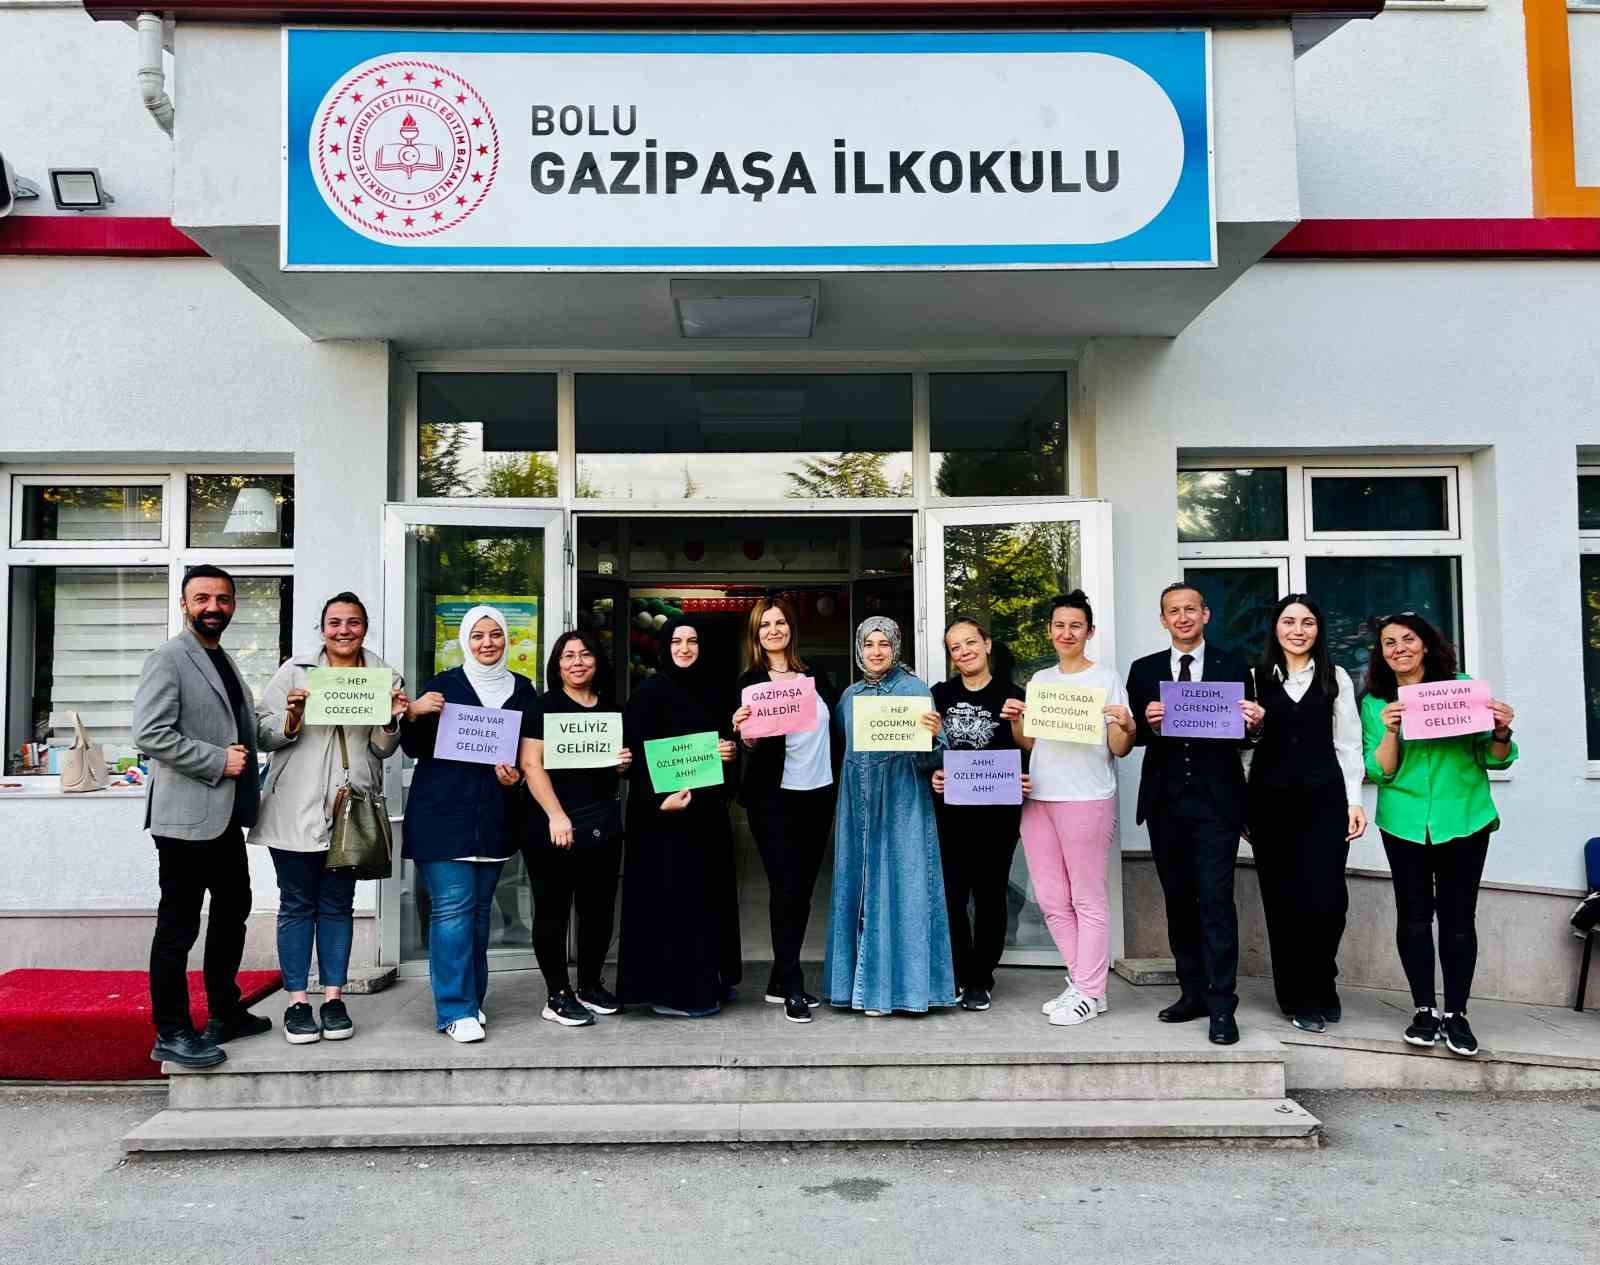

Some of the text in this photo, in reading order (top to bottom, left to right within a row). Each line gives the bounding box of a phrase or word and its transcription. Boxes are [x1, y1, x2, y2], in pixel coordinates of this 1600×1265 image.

[405, 94, 438, 109] MİLLİ
[438, 107, 466, 145] EĞİTİM
[531, 104, 637, 136] BOLU
[353, 94, 401, 161] CUMHURİYETİ
[423, 148, 466, 203] BAKANLIĞI
[530, 138, 1120, 202] GAZİPAŞA İLKOKULU
[347, 677, 367, 686] HEP
[752, 688, 802, 701] GAZİPAŞA
[1058, 693, 1094, 703] OLSADA
[1181, 688, 1224, 699] İZLEDİM,
[1418, 687, 1471, 698] SINAV VAR
[757, 704, 800, 717] AİLEDİR!
[890, 706, 909, 714] HEP
[457, 712, 504, 725] SINAV VAR
[1424, 714, 1472, 728] GELDİK!
[560, 720, 608, 733] VELİYİZ
[456, 741, 498, 754] GELDİK!
[557, 740, 611, 754] GELİRİZ!
[672, 743, 693, 752] AHH!
[686, 753, 714, 764] HANIM
[675, 768, 696, 778] AHH!
[985, 771, 1014, 780] HANIM
[972, 785, 994, 793] AHH!
